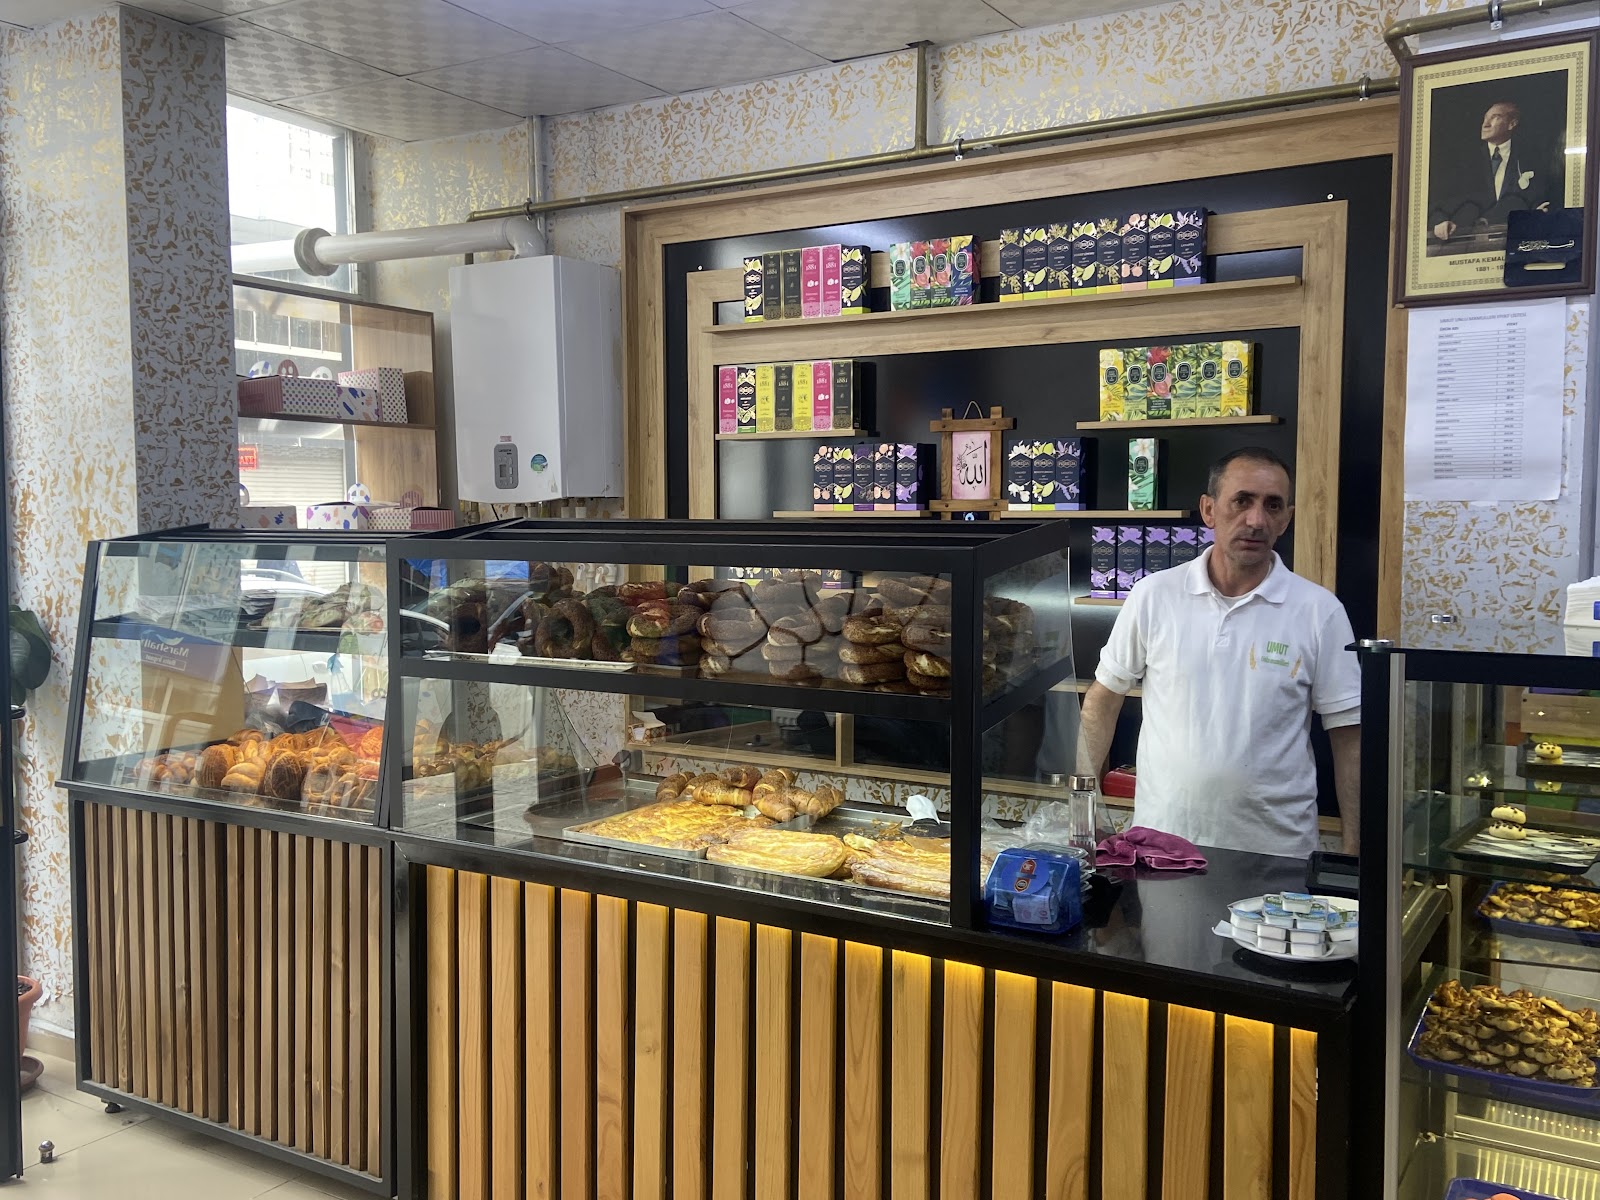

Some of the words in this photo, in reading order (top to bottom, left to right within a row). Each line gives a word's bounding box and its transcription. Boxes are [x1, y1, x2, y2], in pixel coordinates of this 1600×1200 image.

[1449, 257, 1480, 266] MUSTAFA
[240, 455, 254, 464] AFE
[1266, 641, 1289, 656] UMUT
